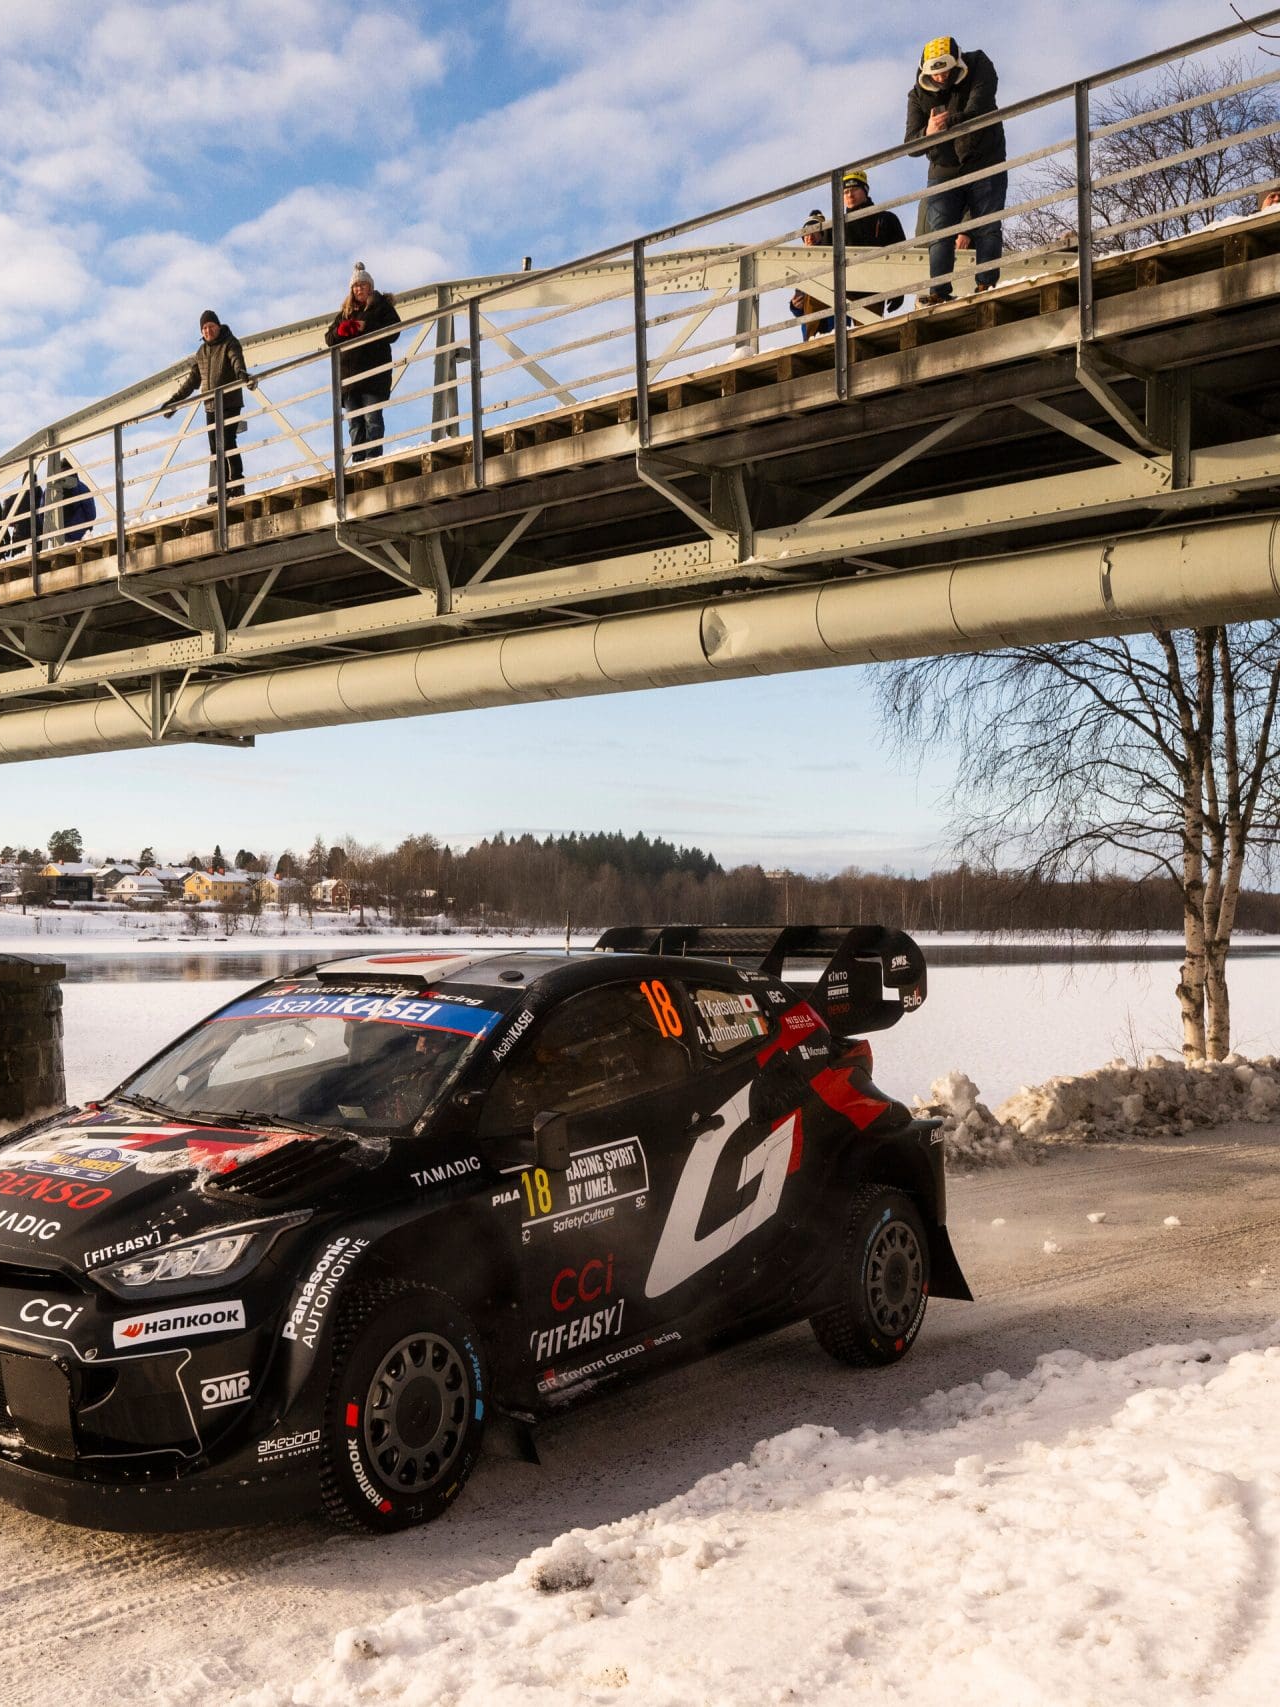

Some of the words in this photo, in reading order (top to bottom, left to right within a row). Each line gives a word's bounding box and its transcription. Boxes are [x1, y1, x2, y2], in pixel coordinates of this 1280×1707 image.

[256, 997, 442, 1022] AsahiKASEI
[420, 991, 484, 1006] Racing
[639, 979, 683, 1038] 18
[904, 990, 922, 1008] Stilo
[492, 1009, 535, 1062] AsahiKASEI
[696, 1022, 753, 1045] A.Johnston
[410, 1156, 481, 1187] TAMADIC
[566, 1153, 605, 1183] RACING
[603, 1146, 637, 1170] SPIRIT
[492, 1189, 520, 1207] PIAA
[521, 1167, 553, 1217] 18
[569, 1184, 584, 1205] BY
[553, 1206, 615, 1233] SafetyCulture
[282, 1236, 350, 1340] Panasonic
[302, 1238, 370, 1349] AUTOMOTIVE
[559, 1360, 606, 1383] TOYOTA
[605, 1344, 645, 1364] GAZOO
[201, 1376, 251, 1403] OMP
